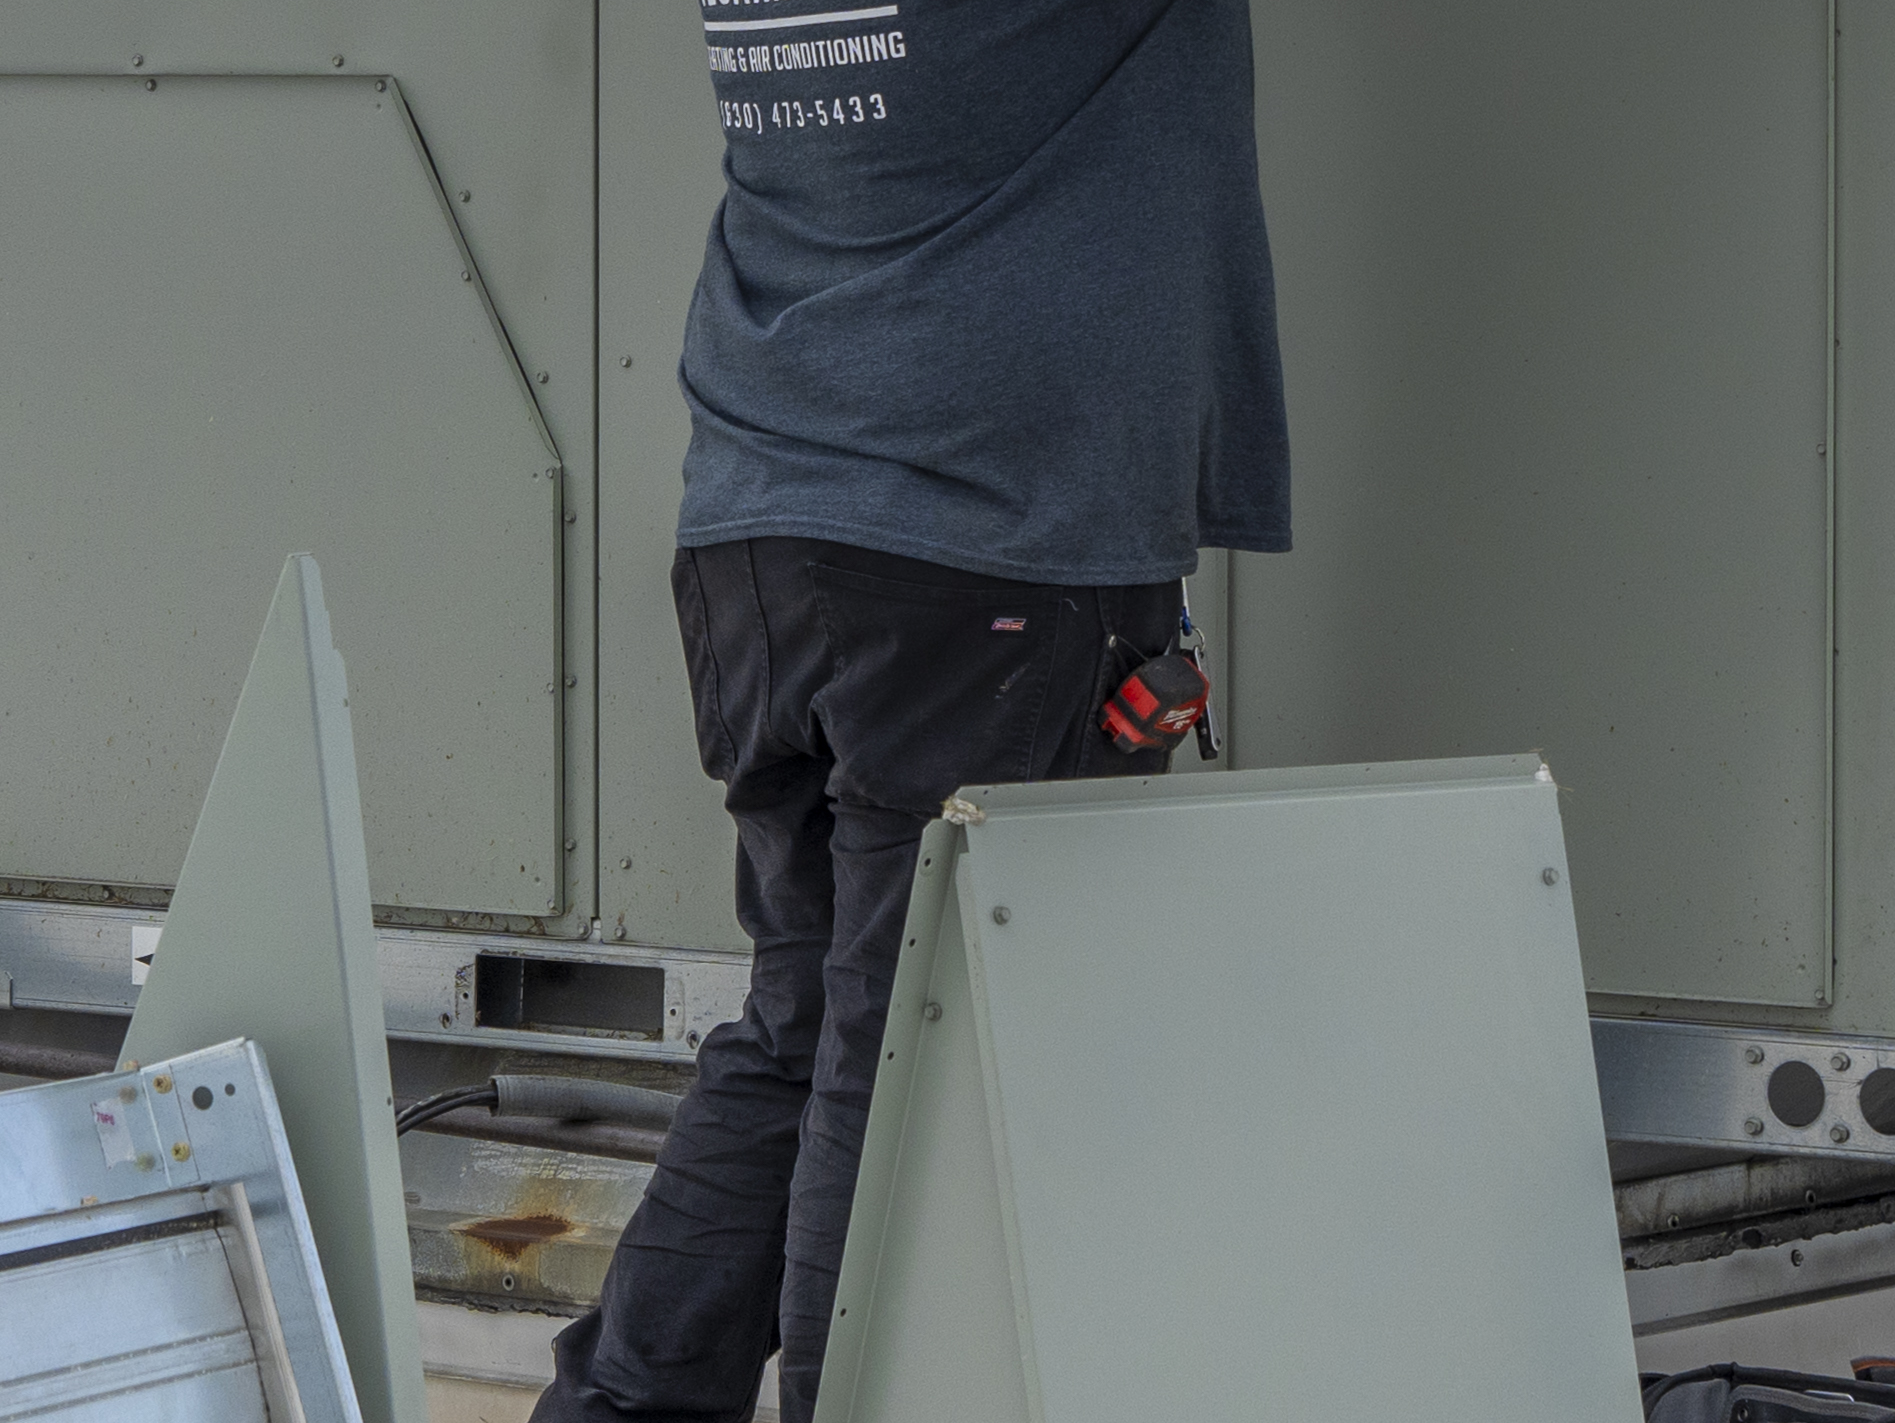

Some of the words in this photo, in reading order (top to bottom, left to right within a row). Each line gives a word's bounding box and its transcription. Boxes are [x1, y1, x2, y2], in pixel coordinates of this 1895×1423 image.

[737, 46, 747, 72] &
[749, 45, 772, 72] AIR
[774, 31, 907, 71] CONDITIONING
[772, 93, 887, 129] 473-5433
